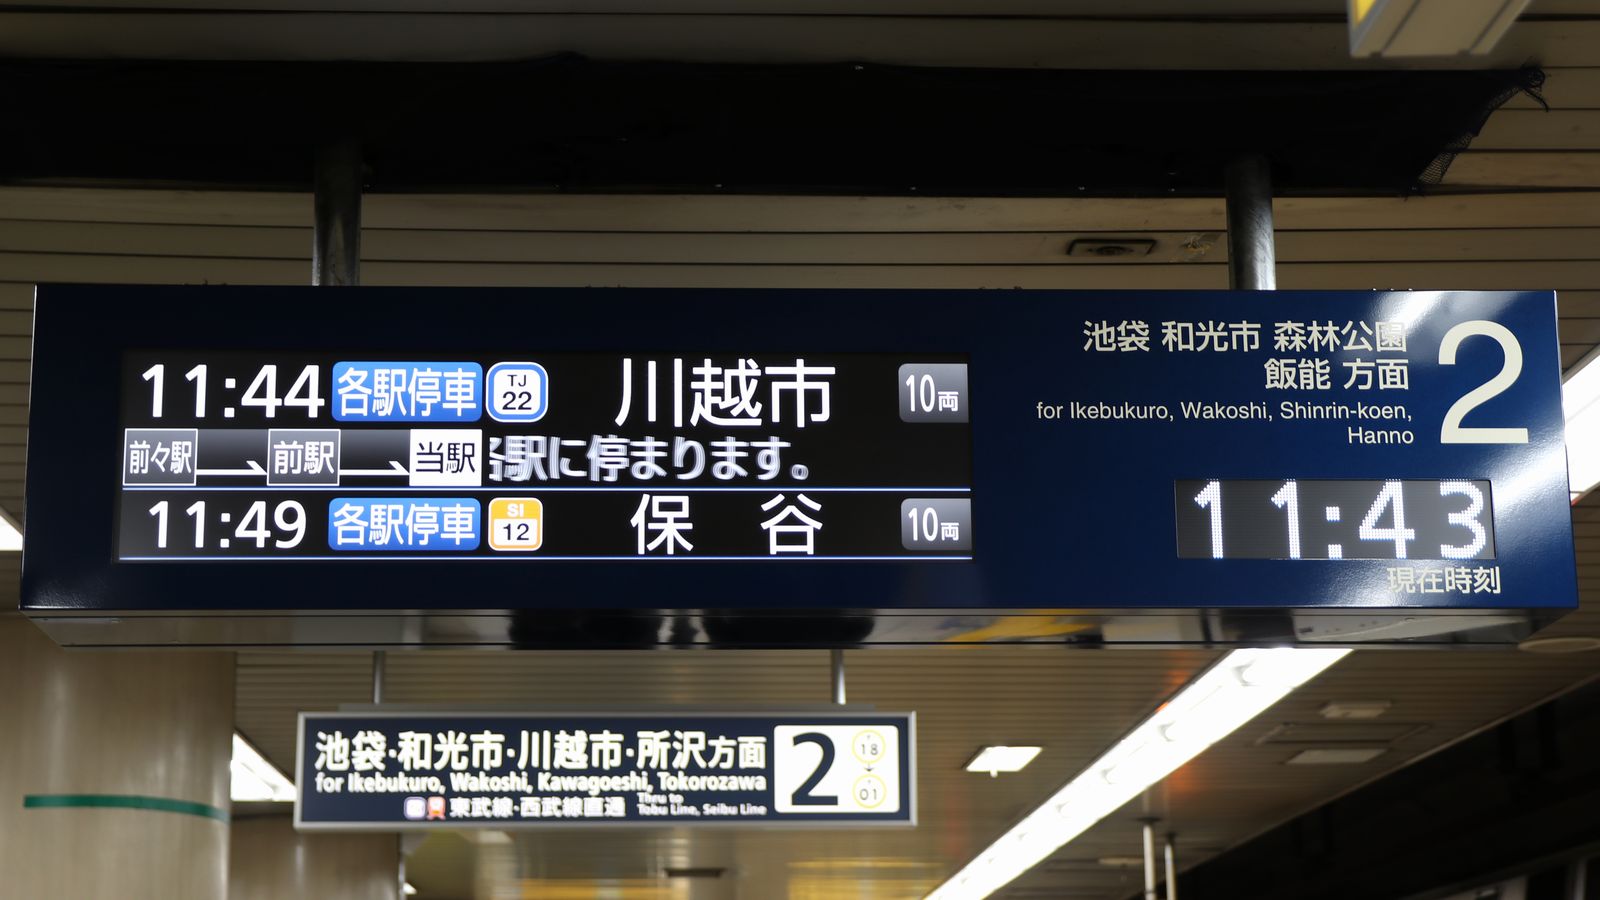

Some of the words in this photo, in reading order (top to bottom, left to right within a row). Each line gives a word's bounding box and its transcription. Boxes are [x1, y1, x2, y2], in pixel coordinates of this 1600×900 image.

[1083, 320, 1149, 353] 池袋
[1161, 320, 1261, 353] 和光市
[1274, 320, 1407, 353] 森林公園
[506, 374, 527, 387] TJ
[1264, 358, 1331, 390] 飯能
[1343, 358, 1409, 390] 方面
[1438, 319, 1529, 444] 2
[142, 364, 325, 418] 11:44
[337, 367, 478, 417] 各駅停車
[502, 391, 532, 411] 22
[615, 357, 836, 428] 川越市
[905, 373, 959, 414] 10両
[1036, 402, 1064, 419] for
[1070, 402, 1174, 422] Ikebukuro,
[1180, 402, 1273, 422] Wakoshi,
[1280, 402, 1412, 422] Shinrin-koen,
[1348, 427, 1414, 444] Hanno
[129, 440, 192, 475] 前々駅
[273, 440, 335, 475] 前駅
[415, 442, 476, 474] 当駅
[148, 501, 307, 548] 11:49
[333, 503, 476, 546] 各駅停車
[507, 503, 525, 517] SI
[907, 506, 960, 542] 10両
[1194, 478, 1487, 559] 11:43
[503, 523, 530, 541] 12
[1387, 566, 1501, 595] 現在時刻
[861, 743, 878, 755] 18
[315, 772, 344, 793] for
[348, 772, 446, 794] Ikebukuro,
[450, 772, 533, 794] Wakoshi,
[538, 772, 653, 796] Kawagoeshi,
[657, 772, 767, 792] Tokorozawa
[791, 731, 838, 807] 2
[637, 803, 669, 816] Tobu
[702, 803, 738, 815] Seibu
[740, 803, 767, 815] Line
[859, 787, 877, 801] 01
